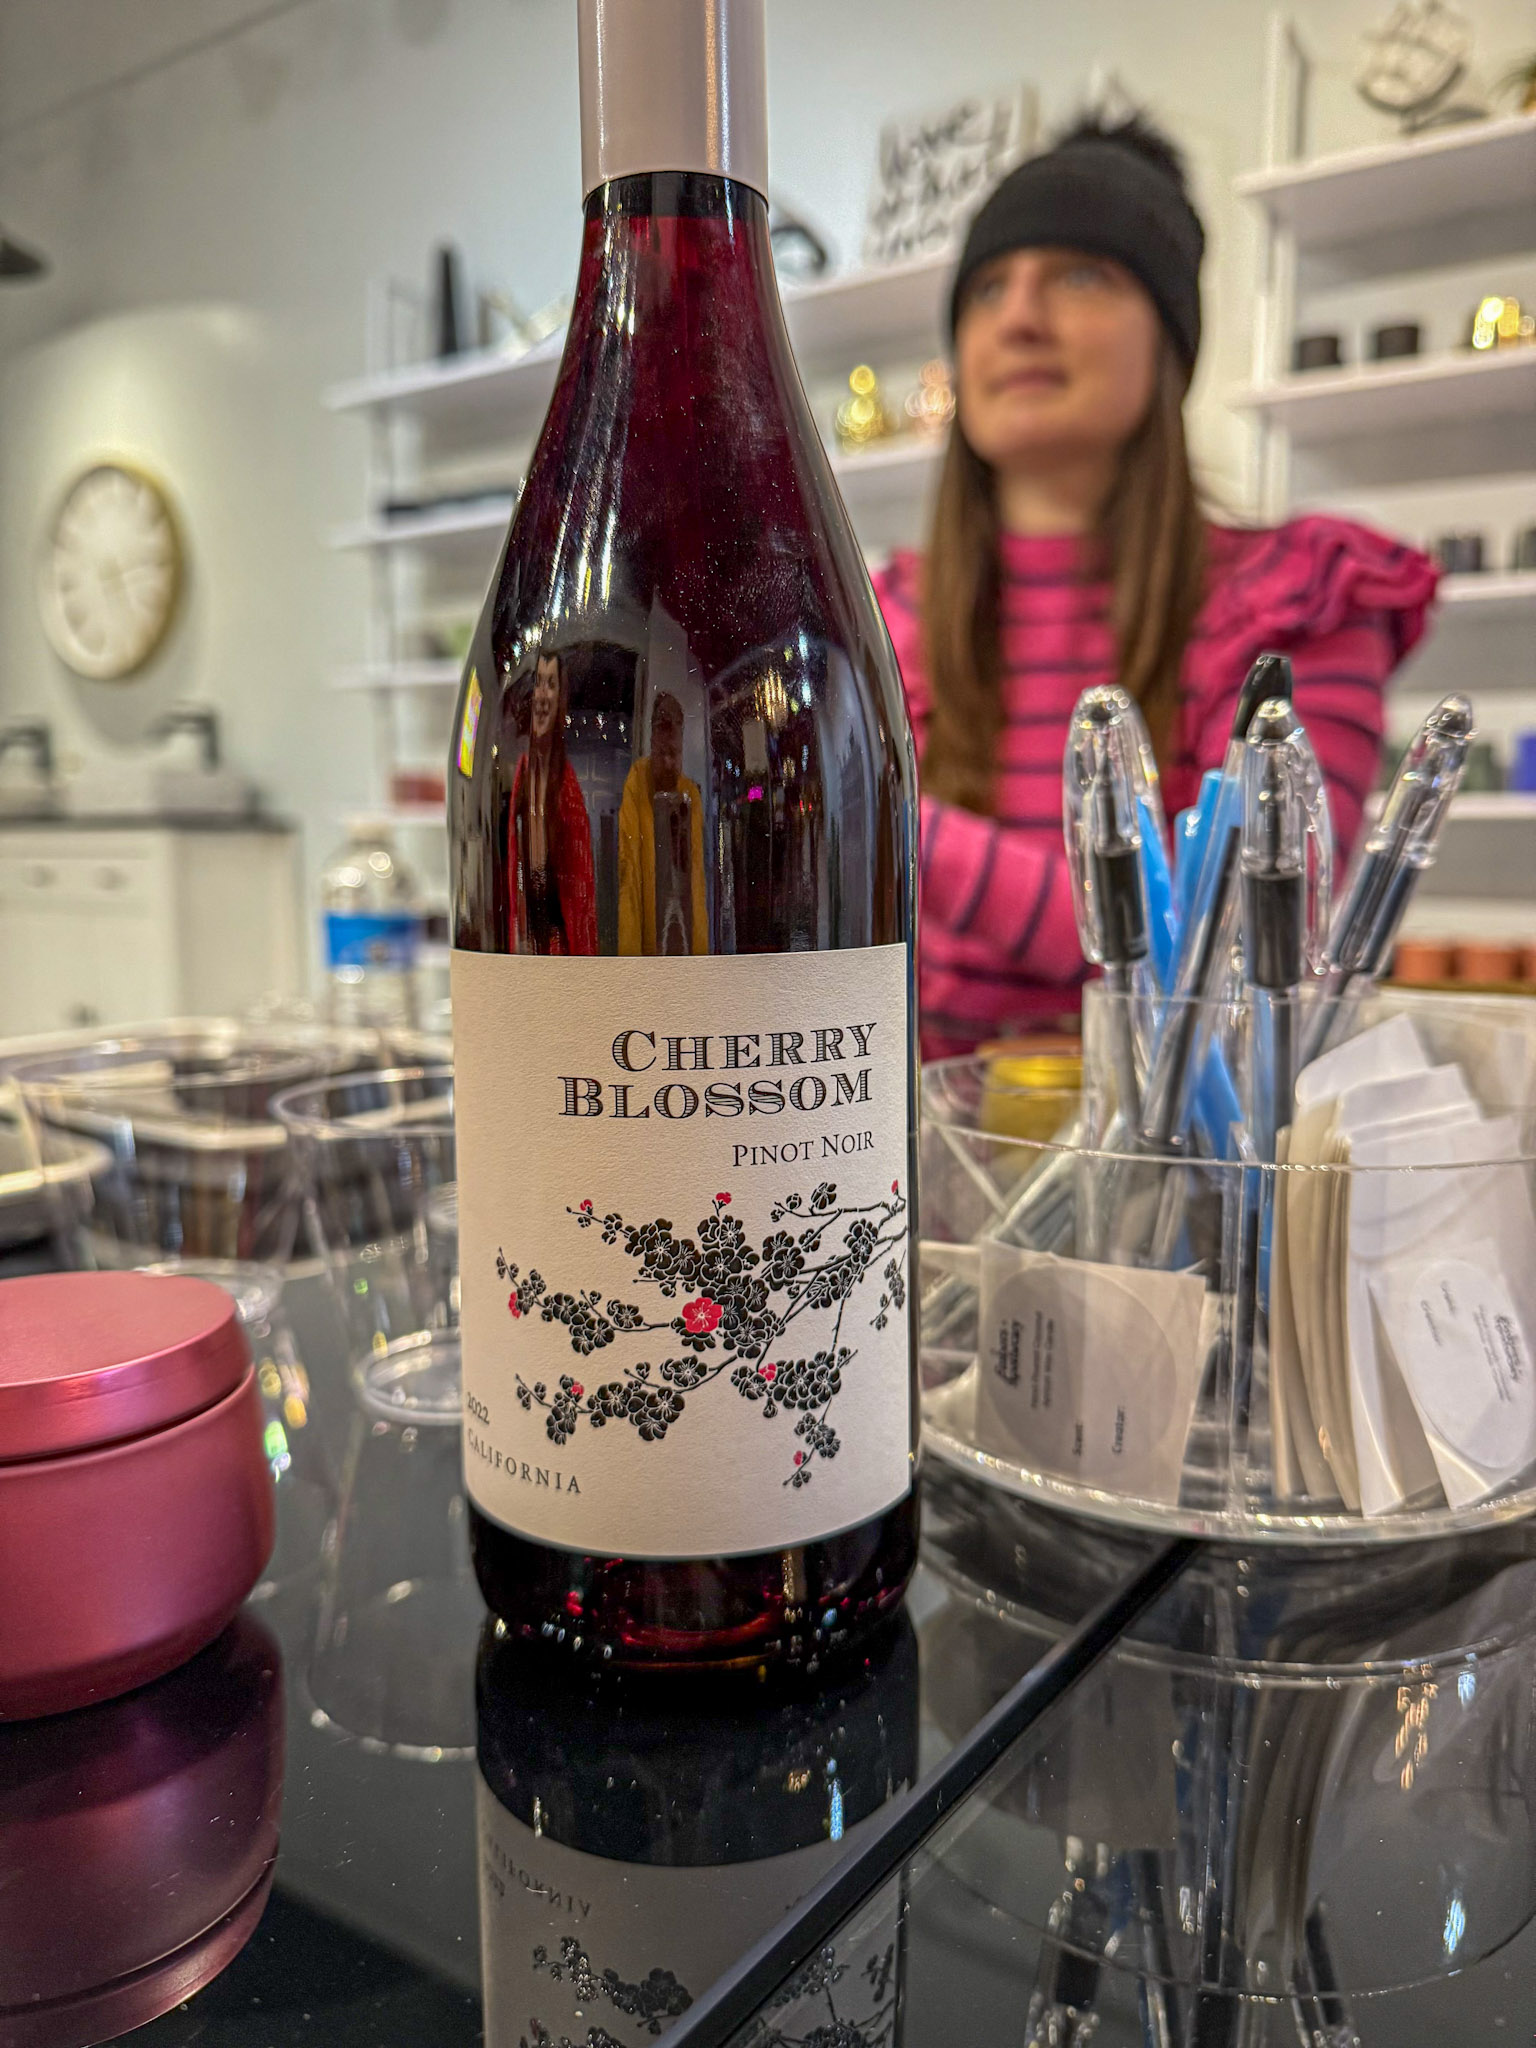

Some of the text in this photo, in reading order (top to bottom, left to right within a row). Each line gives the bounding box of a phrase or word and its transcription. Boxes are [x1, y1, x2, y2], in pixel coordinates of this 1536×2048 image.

[611, 1021, 877, 1072] CHERRY
[557, 1067, 873, 1119] BLOSSOM
[732, 1130, 875, 1167] PINOT NOIR
[467, 1391, 490, 1425] 2022
[468, 1428, 581, 1494] CALIFORNIA
